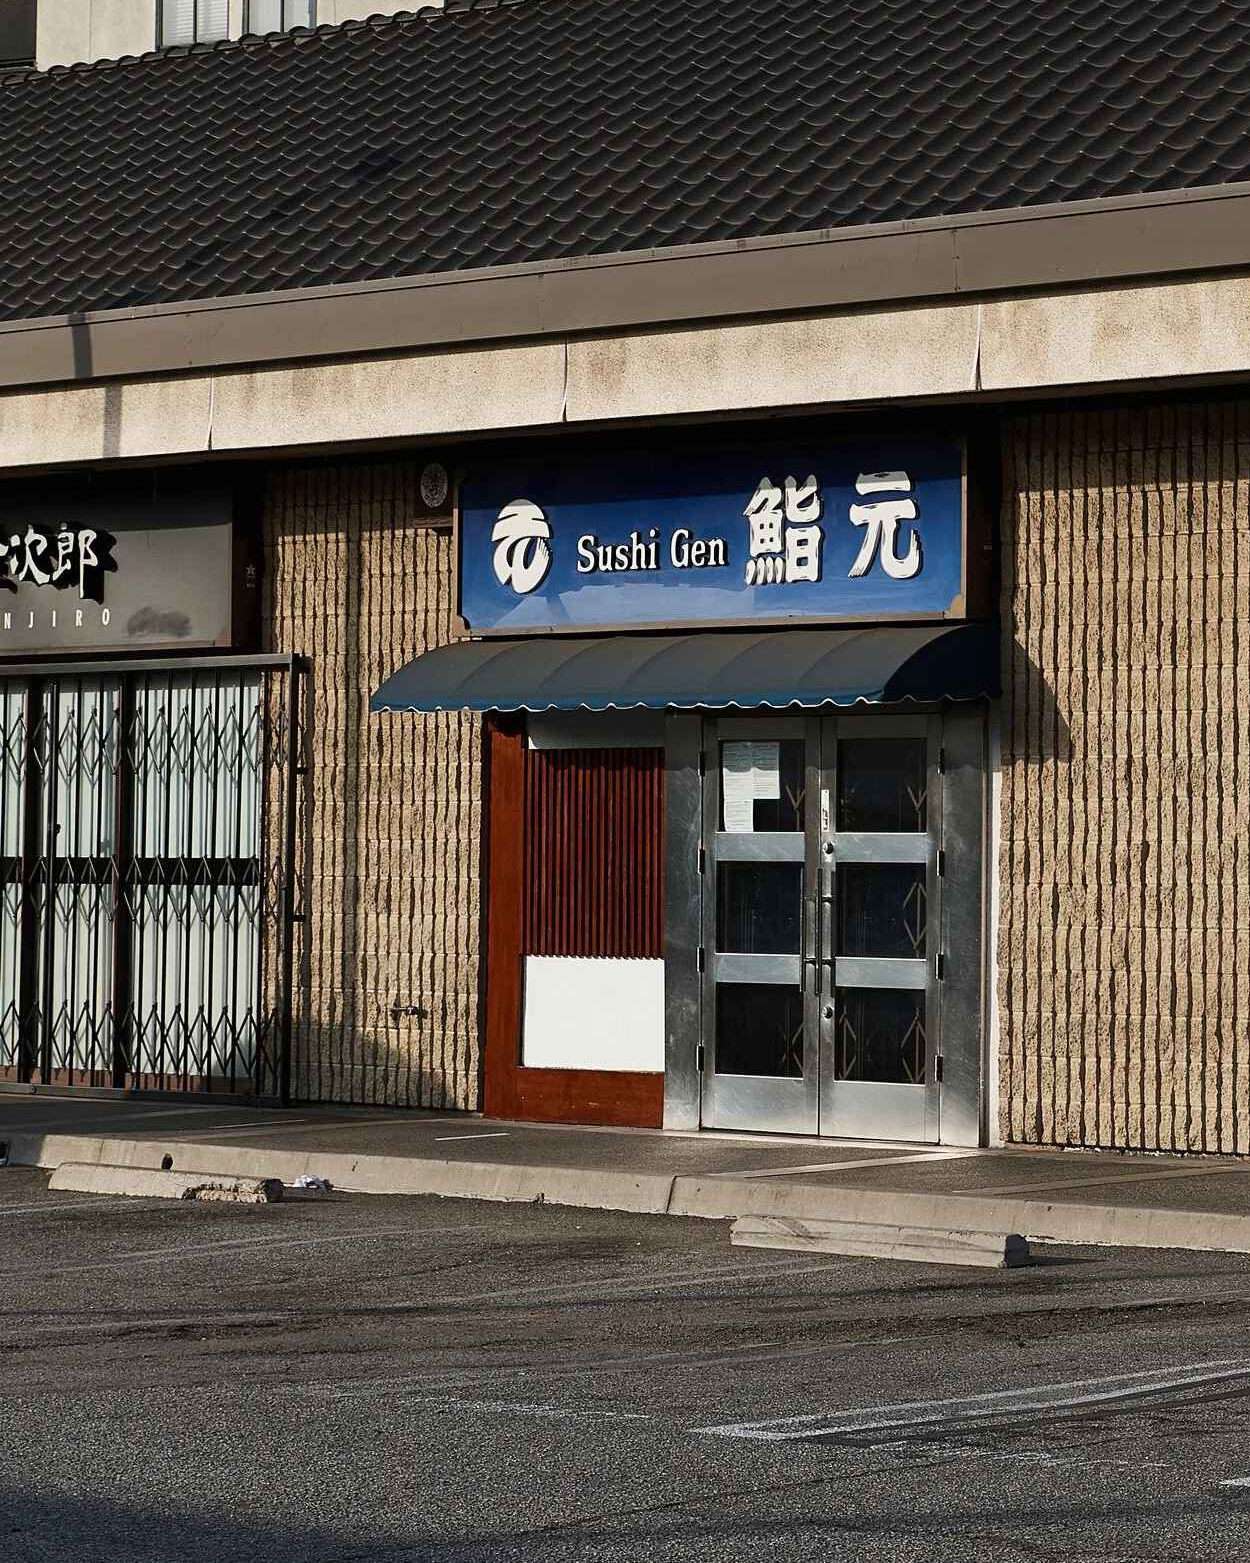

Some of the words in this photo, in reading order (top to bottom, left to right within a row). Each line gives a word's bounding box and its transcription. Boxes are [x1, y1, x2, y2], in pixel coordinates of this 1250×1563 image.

[0, 522, 98, 599] 次郎
[577, 529, 659, 573] Sushi
[670, 528, 727, 568] Gen
[742, 470, 923, 586] 鮨元
